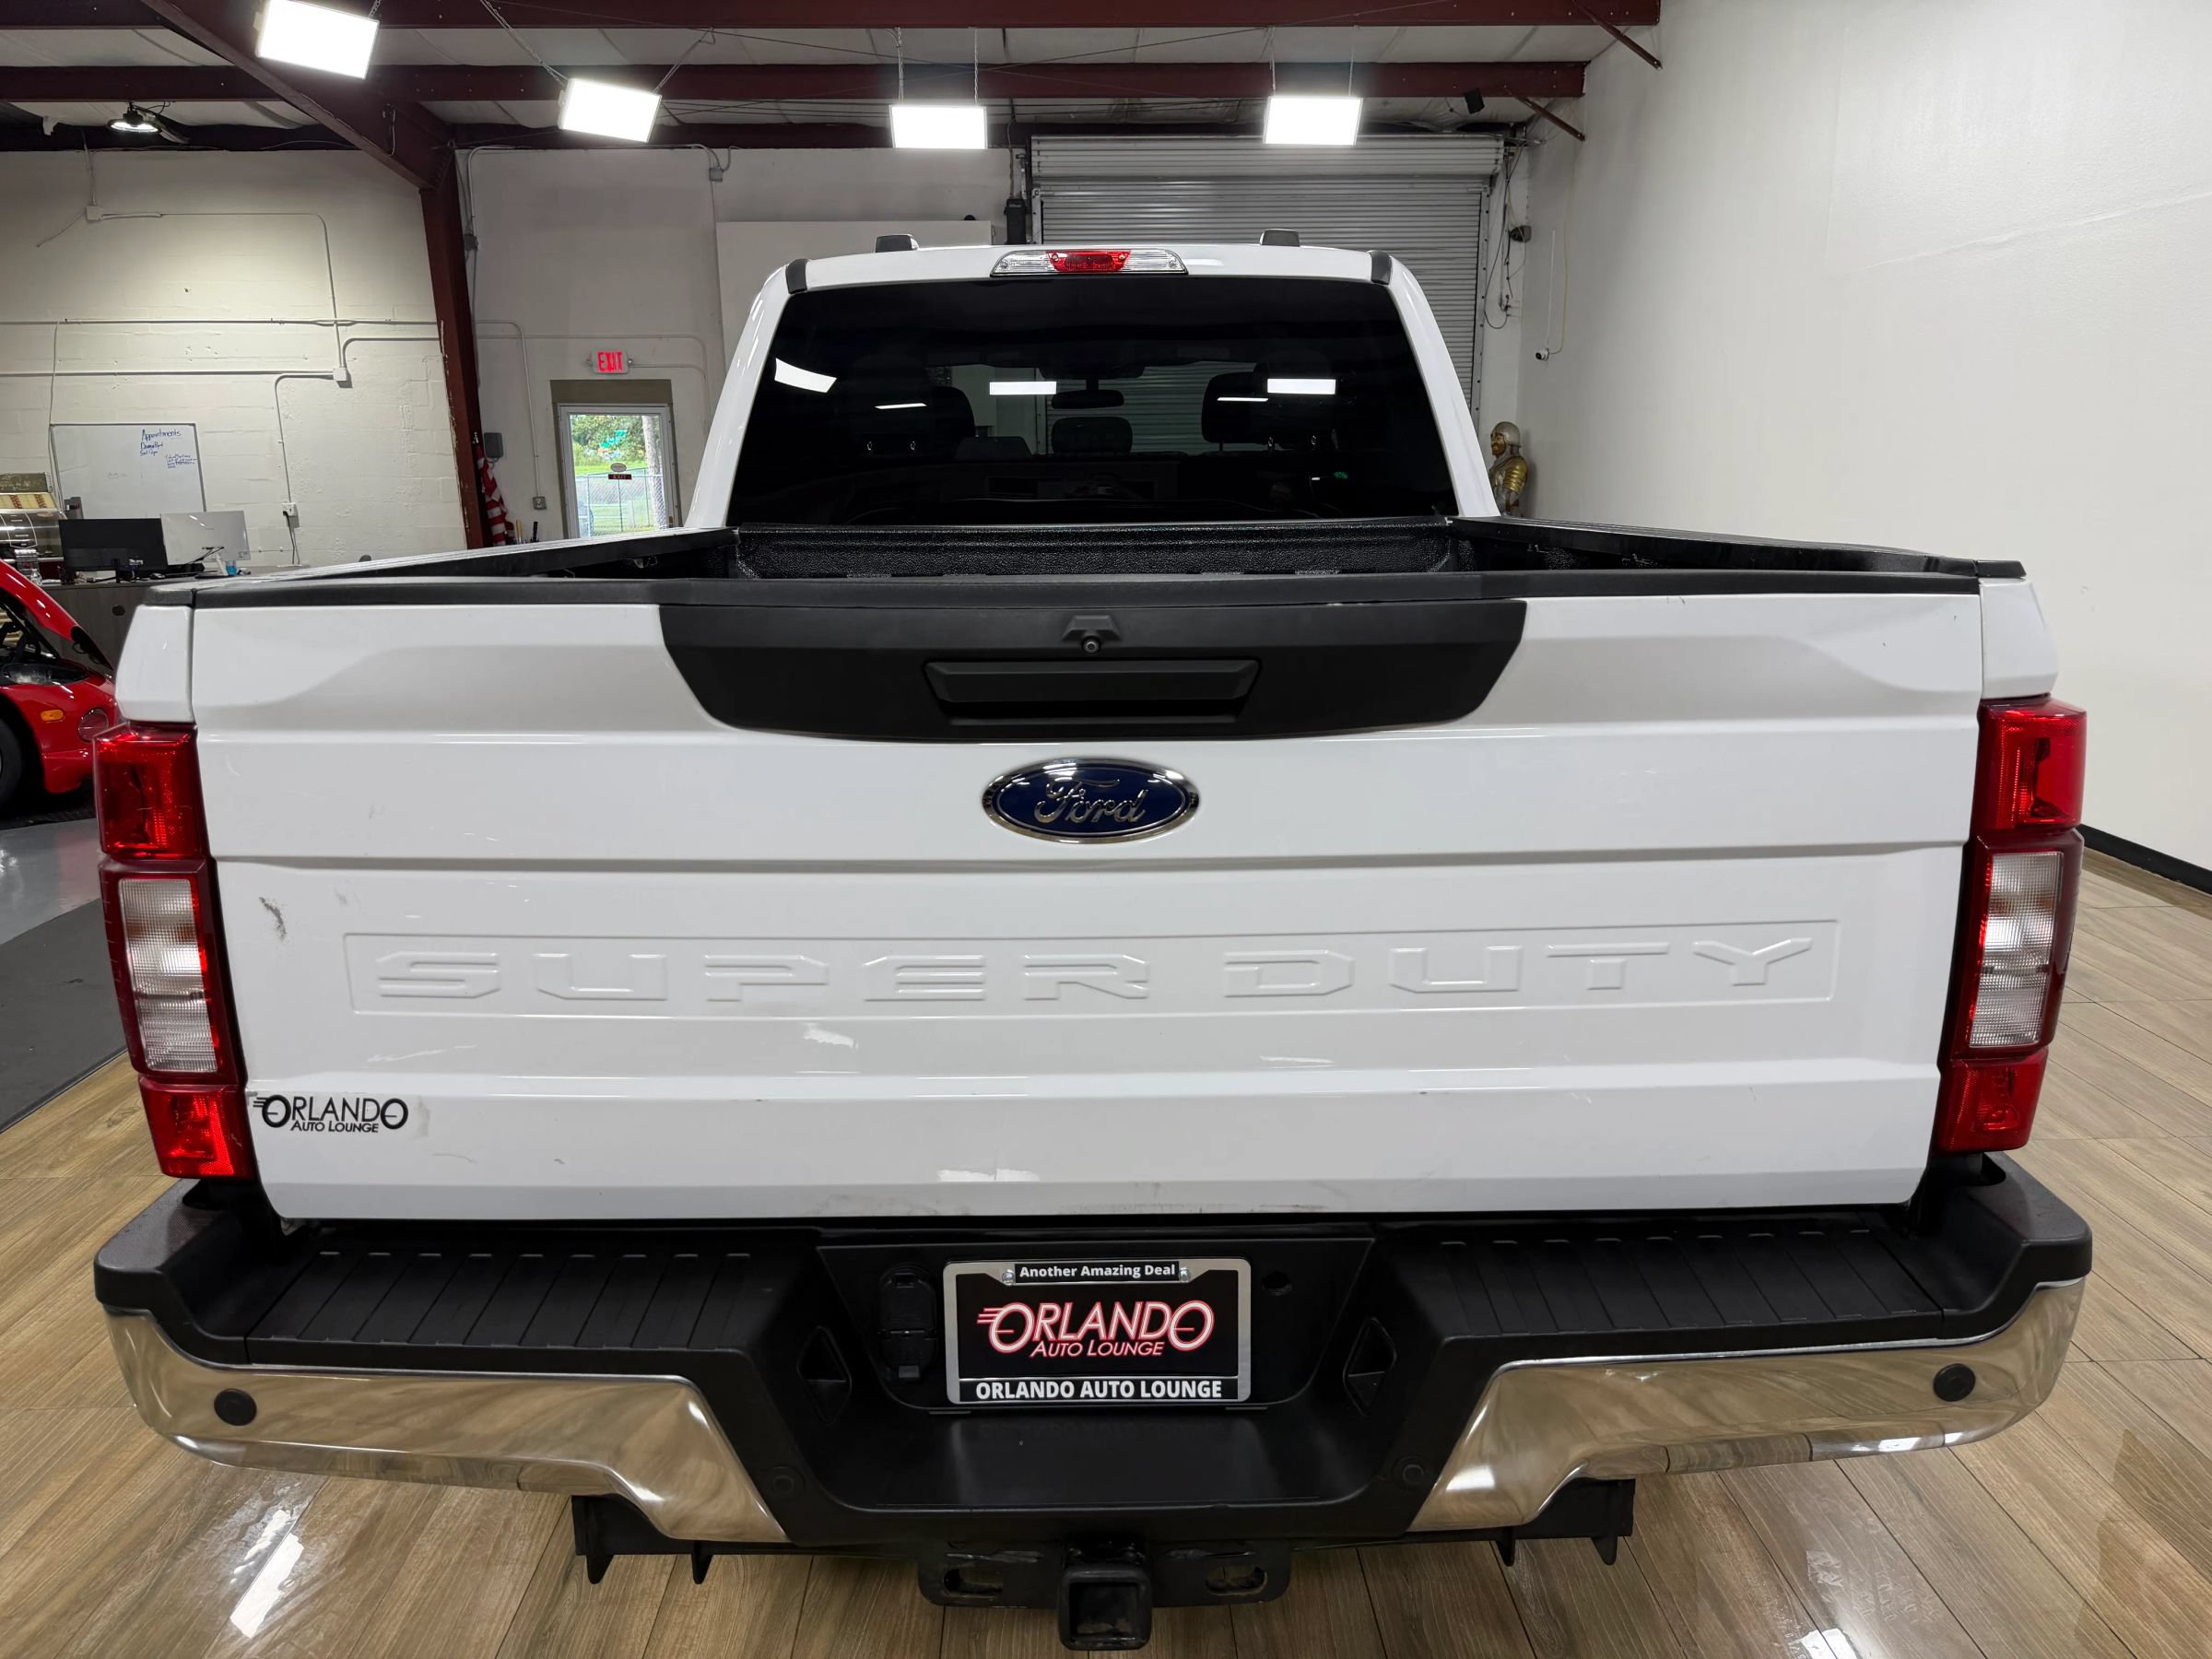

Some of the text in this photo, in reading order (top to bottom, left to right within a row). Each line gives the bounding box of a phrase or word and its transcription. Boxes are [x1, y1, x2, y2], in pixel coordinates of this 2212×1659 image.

[597, 351, 623, 371] EXIT
[141, 429, 182, 441] Appointments
[1033, 778, 1149, 823] Ford
[375, 936, 1814, 1003] SUPER DUTY
[261, 1094, 408, 1130] ORLANDO
[290, 1120, 379, 1133] AUTO LOUNGE
[1019, 1264, 1175, 1278] Another Amazing Deal
[987, 1300, 1215, 1352] ORLANDO
[1029, 1340, 1165, 1358] AUTO LOUNGE
[976, 1381, 1222, 1399] ORLANDO AUTO LOUNGE
